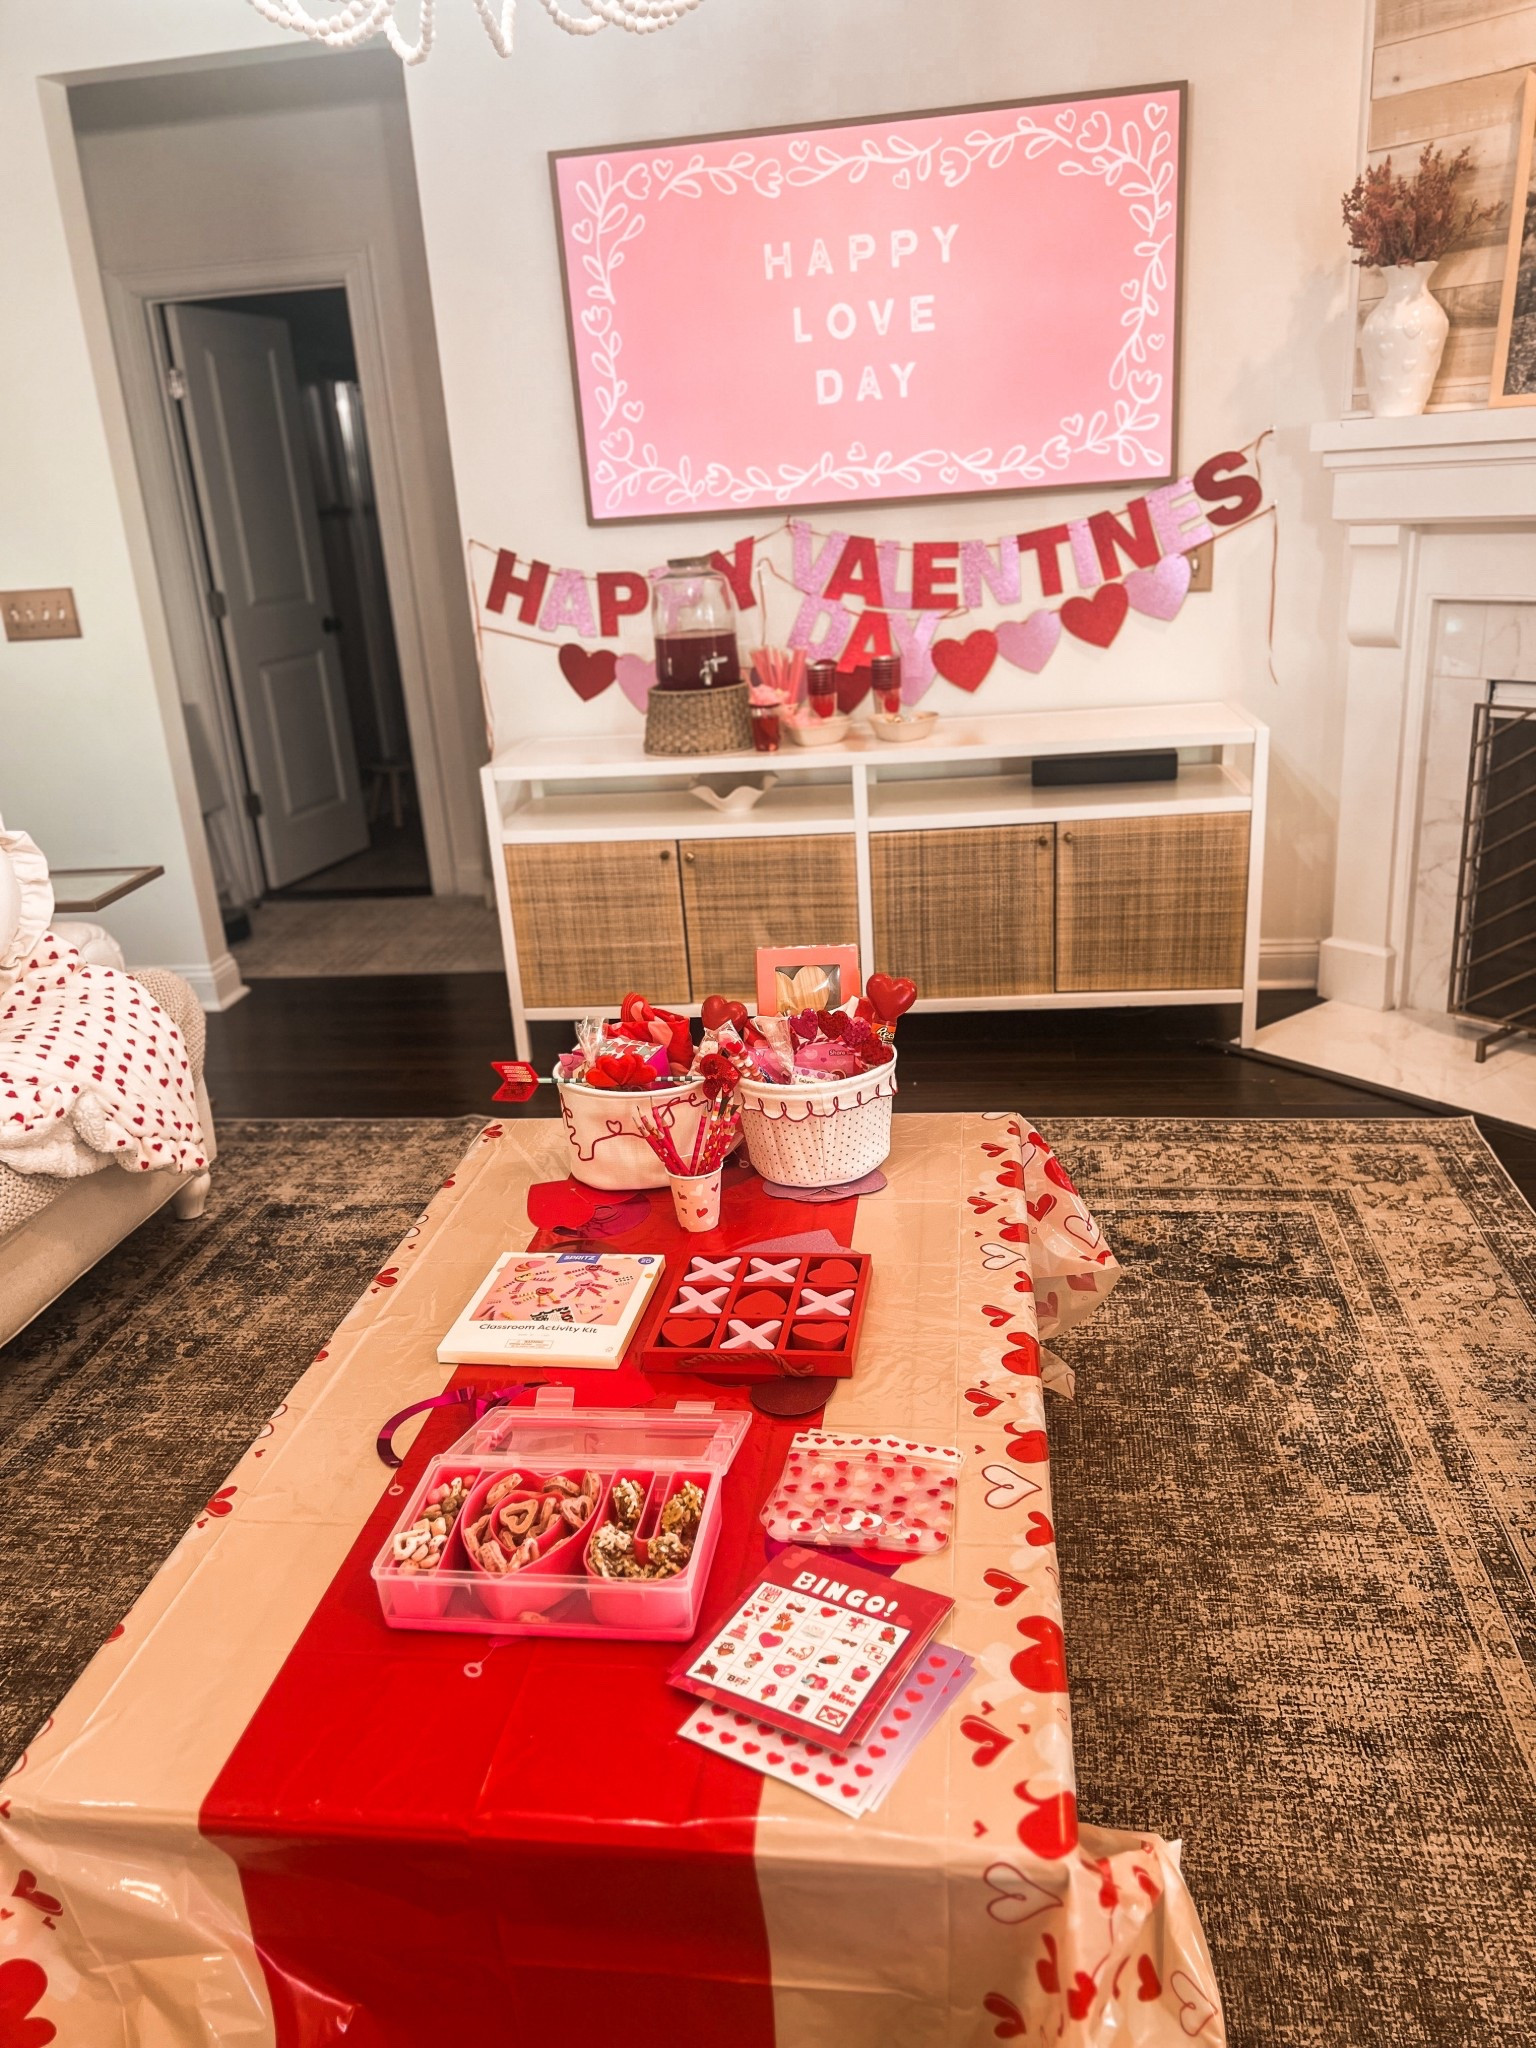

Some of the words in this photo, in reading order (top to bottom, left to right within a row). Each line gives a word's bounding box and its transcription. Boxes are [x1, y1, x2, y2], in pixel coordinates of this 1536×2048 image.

[763, 223, 960, 281] HAPPY
[792, 294, 936, 343] LOVE
[815, 361, 917, 405] DAY
[790, 451, 1263, 610] VALENTINES
[786, 594, 944, 678] DAY
[479, 1323, 535, 1331] Classroom
[537, 1323, 581, 1334] Activity
[582, 1326, 599, 1335] Kit
[792, 1571, 898, 1617] BINGO!
[727, 1674, 750, 1688] BFF
[828, 1690, 857, 1709] Mine
[841, 1684, 857, 1696] Be
